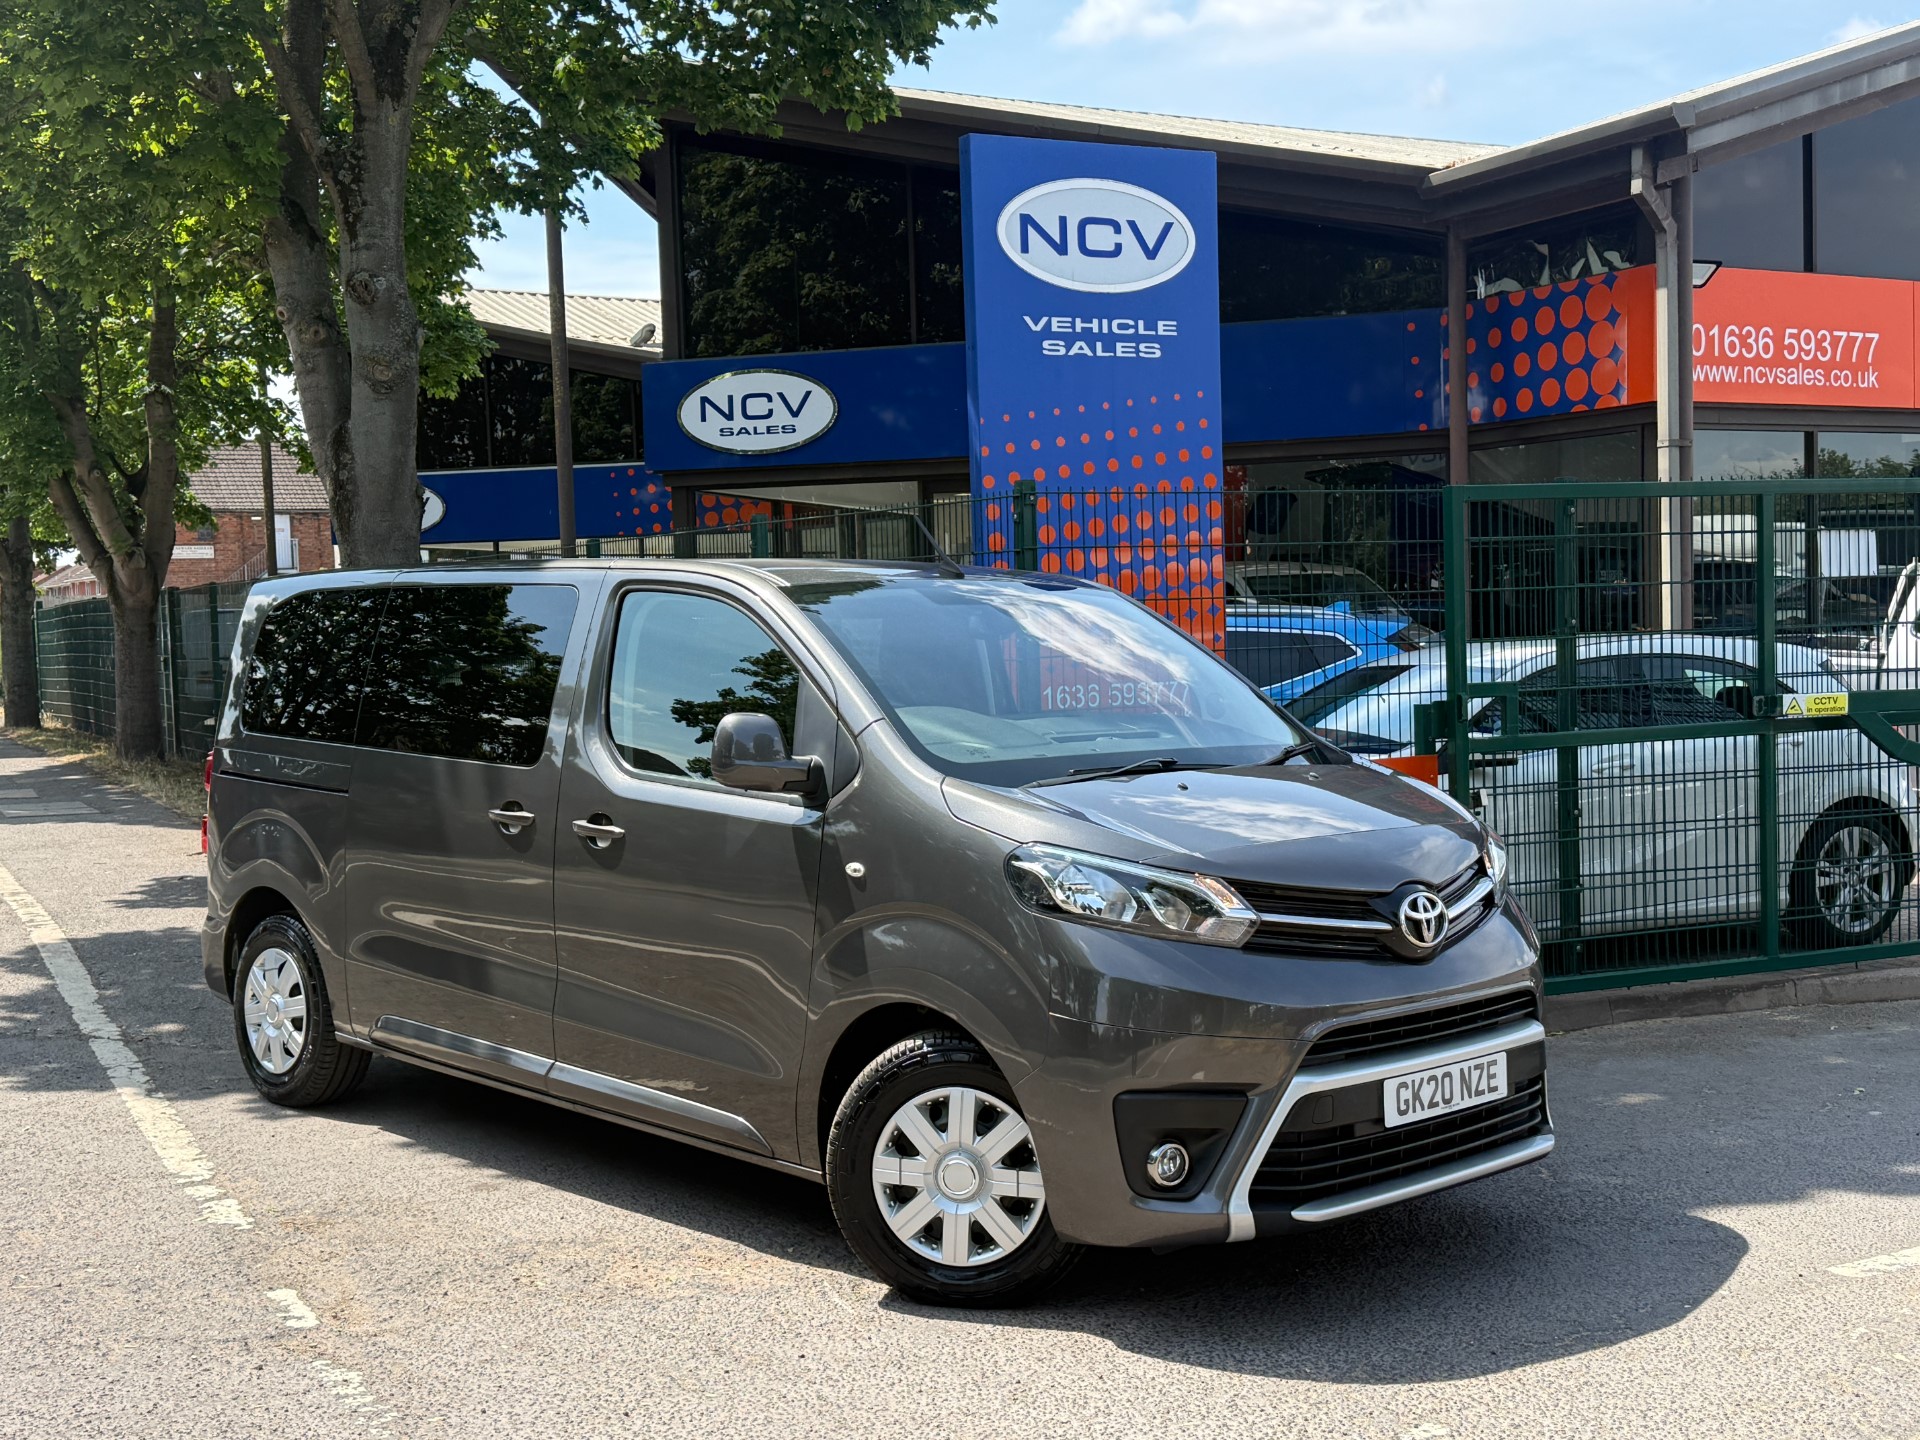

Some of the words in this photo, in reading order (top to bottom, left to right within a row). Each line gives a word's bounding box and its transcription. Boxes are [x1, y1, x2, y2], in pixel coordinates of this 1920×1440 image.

[1018, 213, 1175, 261] NCV
[1022, 315, 1178, 336] VEHICLE
[1042, 339, 1162, 358] SALES
[1692, 323, 1774, 359] 01636
[1783, 328, 1880, 364] 593777
[1692, 362, 1879, 389] www.ncvsales.co.uk
[699, 390, 812, 422] NCV
[719, 424, 797, 437] SALES
[1813, 697, 1838, 705] CCTV
[1814, 706, 1845, 714] operation
[1395, 1070, 1454, 1117] GK20
[1459, 1058, 1499, 1101] NZE
